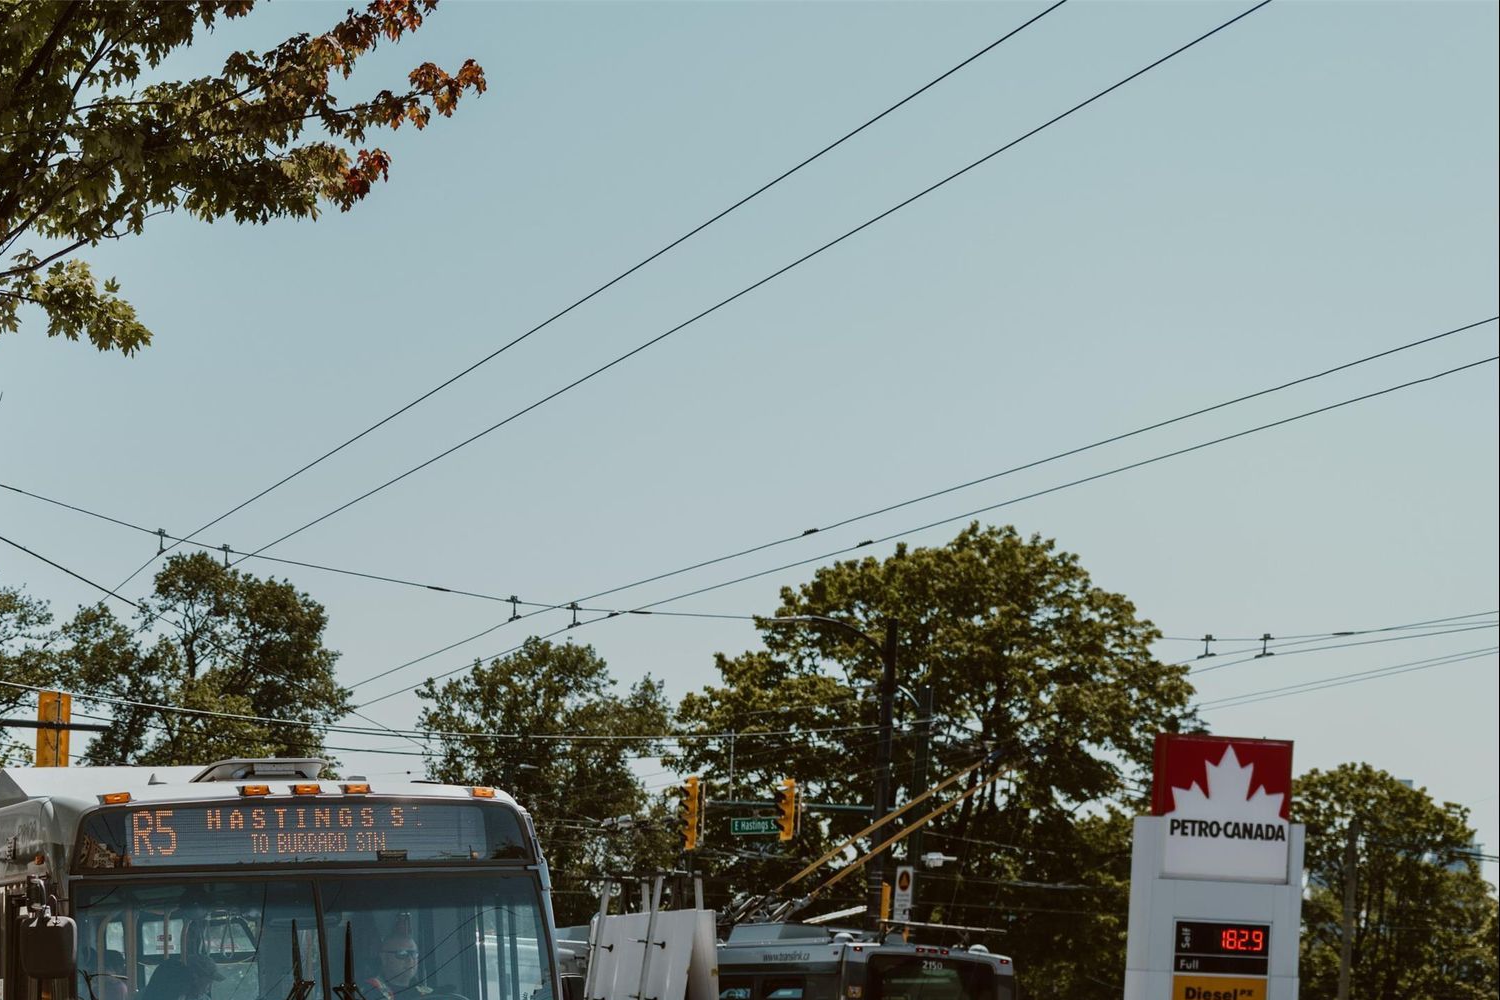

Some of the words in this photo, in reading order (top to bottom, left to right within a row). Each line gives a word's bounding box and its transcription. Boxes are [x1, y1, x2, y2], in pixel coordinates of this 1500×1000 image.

[132, 810, 178, 856] R5
[206, 806, 375, 829] HASTINGS
[734, 820, 740, 831] E
[740, 820, 769, 833] Hastings
[251, 833, 269, 854] TO
[276, 832, 348, 853] BURRARD
[355, 831, 387, 852] STN
[1181, 928, 1191, 948] Self
[1221, 929, 1264, 951] 182.9
[922, 960, 943, 971] 2150
[1179, 959, 1199, 970] Full
